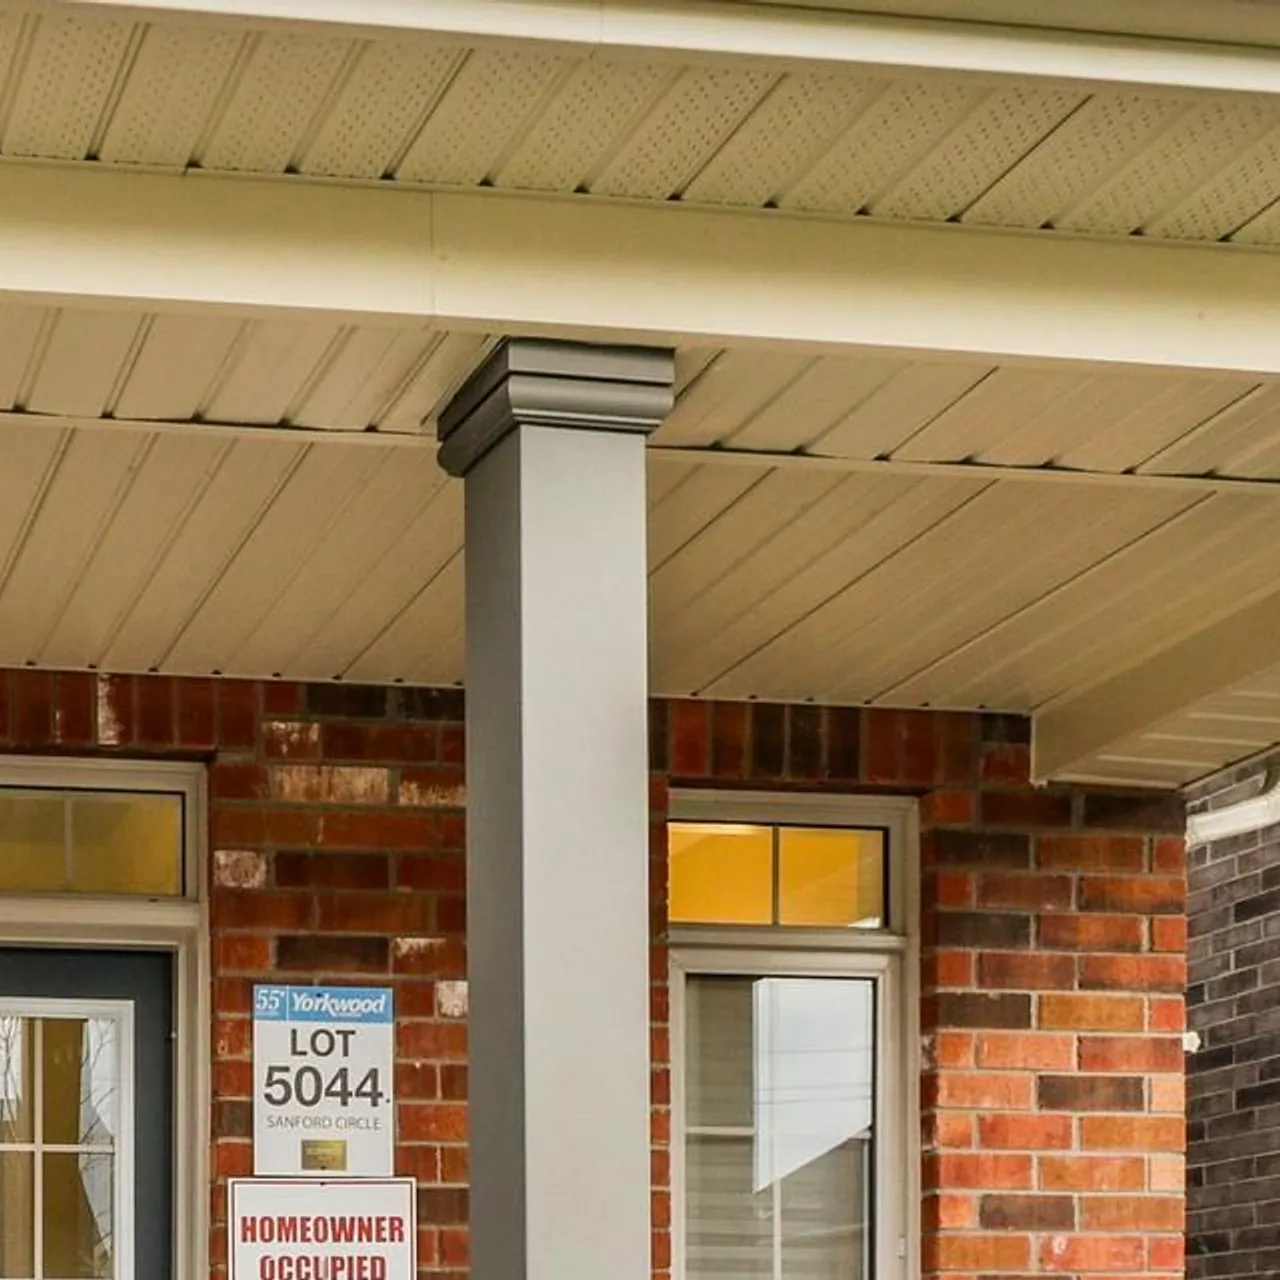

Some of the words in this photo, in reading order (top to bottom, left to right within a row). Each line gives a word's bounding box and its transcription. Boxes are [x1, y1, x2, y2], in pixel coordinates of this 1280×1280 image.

[292, 992, 386, 1016] Yorkwood
[290, 1028, 356, 1057] LOT
[266, 1115, 332, 1129] SANFORD
[335, 1117, 382, 1130] CIRCLE
[241, 1215, 405, 1243] HOMEOWNER
